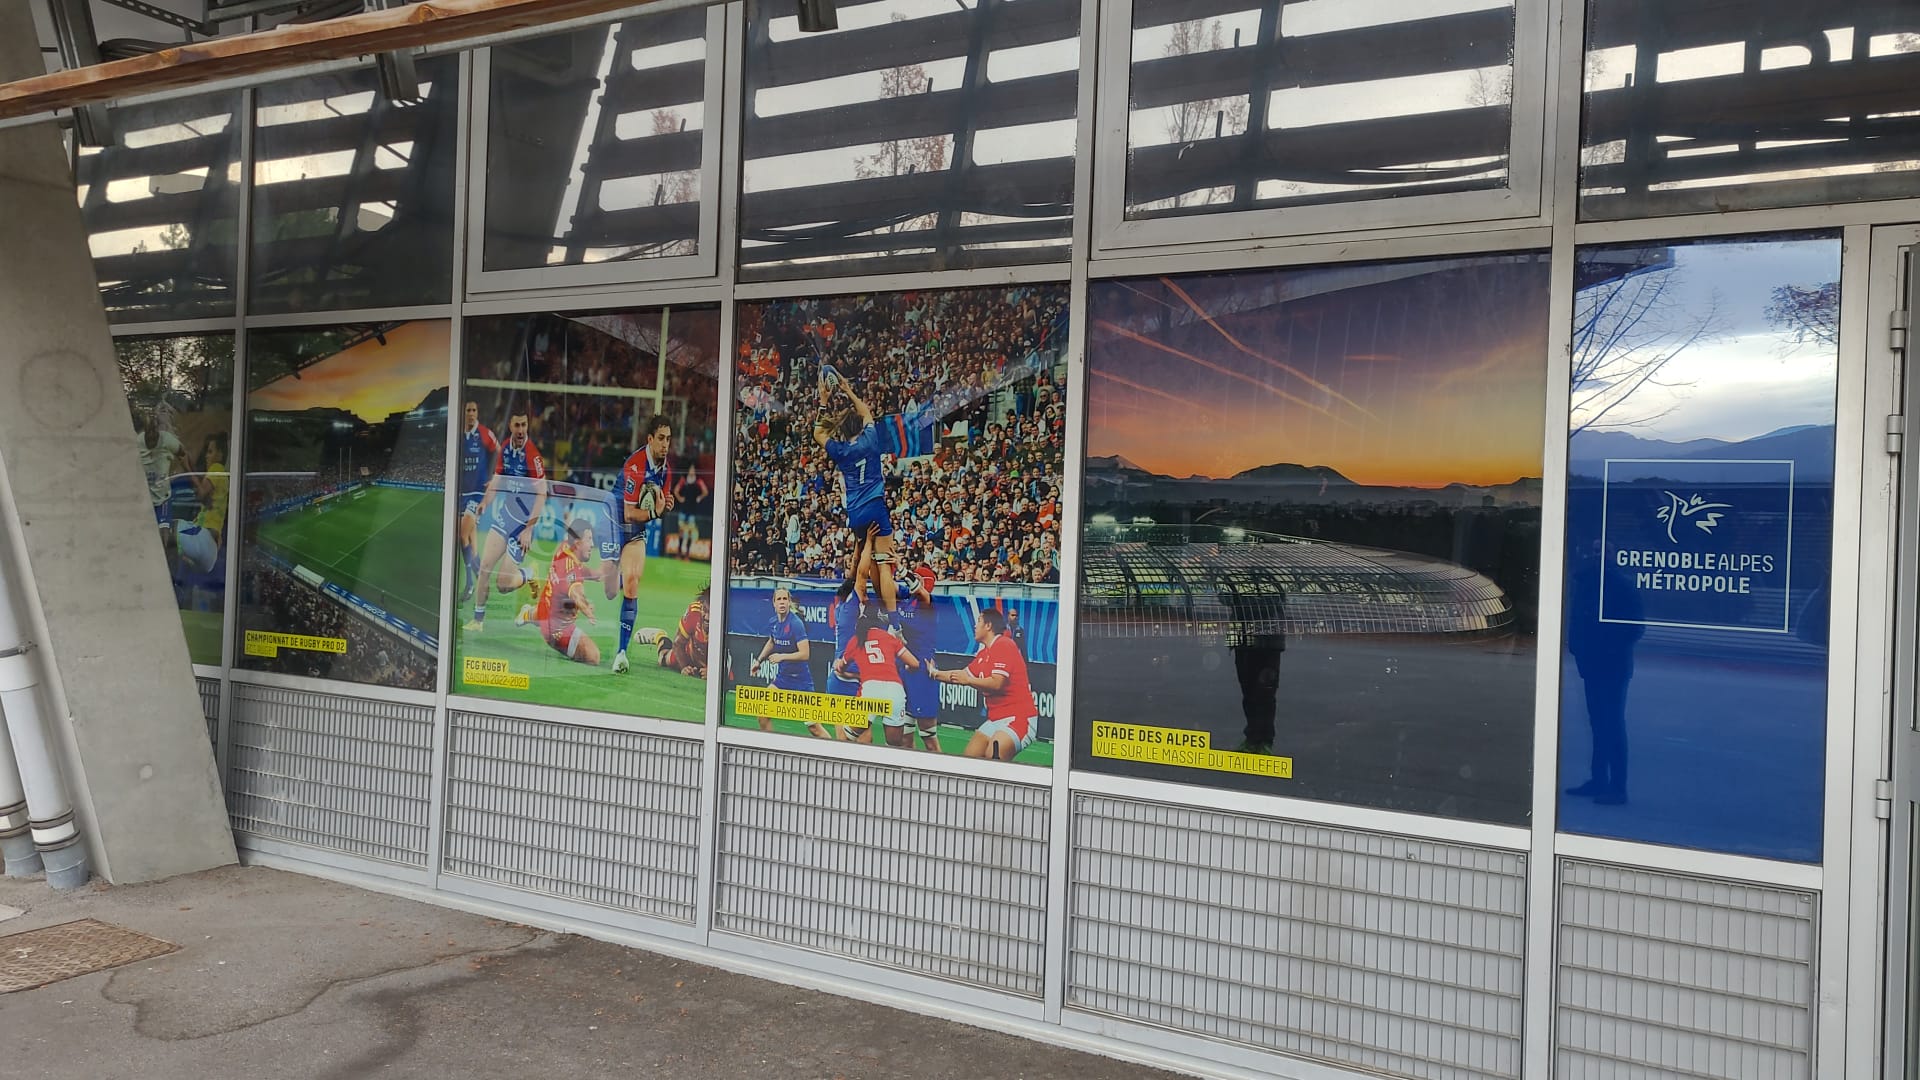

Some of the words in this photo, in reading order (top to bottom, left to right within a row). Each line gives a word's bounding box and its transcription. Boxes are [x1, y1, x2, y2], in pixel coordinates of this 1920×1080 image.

[1636, 569, 1750, 594] MÉTROPOLE
[799, 605, 827, 623] RANCE
[246, 632, 289, 645] CHAMPIONNAT
[290, 637, 299, 647] DE
[299, 638, 321, 649] RUGBY
[322, 640, 335, 650] PRO
[336, 641, 345, 651] D2
[864, 640, 886, 664] 5
[466, 659, 480, 670] FCG
[481, 660, 507, 672] RUGBY
[465, 671, 489, 684] SAISON
[490, 674, 528, 688] 2022-2023
[738, 686, 770, 702] ÉQUIPE
[772, 691, 784, 703] DE
[786, 692, 822, 707] FRANCE
[844, 698, 890, 714] FÉMININE
[738, 701, 768, 715] FRANCE
[776, 705, 797, 719] PAYS
[799, 708, 810, 720] DE
[812, 709, 843, 723] GALLES
[844, 712, 867, 726] 2023
[1096, 725, 1135, 741] STADE
[1138, 729, 1162, 744] DES
[1166, 732, 1206, 749] ALPES
[1096, 741, 1117, 756] VUE
[1120, 743, 1143, 759] SUR
[1146, 746, 1159, 761] LE
[1162, 748, 1205, 766] MASSIF
[1208, 753, 1224, 768] DU
[1228, 755, 1289, 775] TAILLEFER
